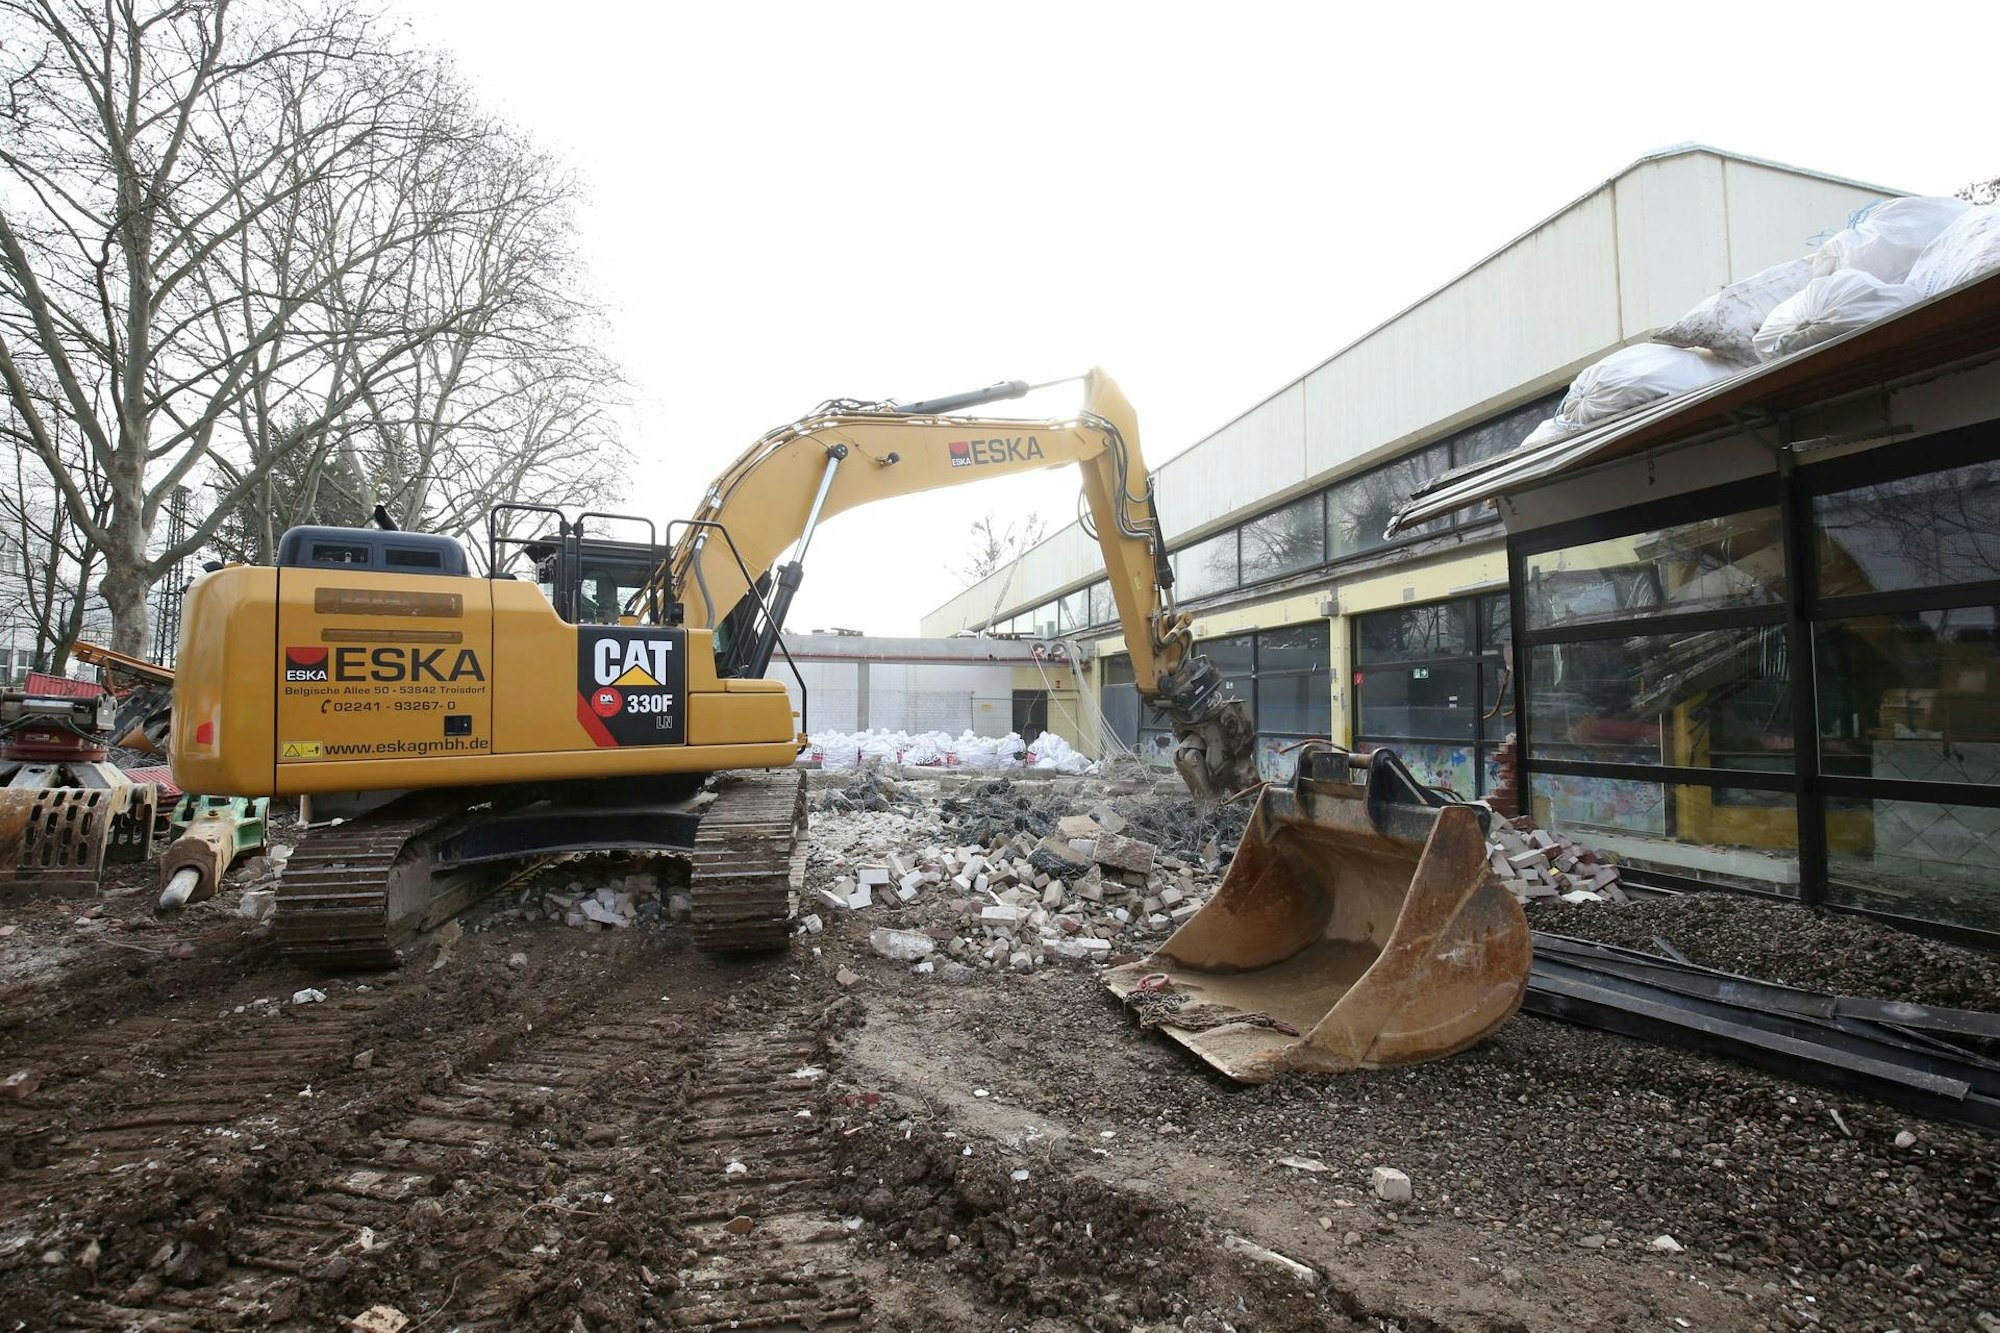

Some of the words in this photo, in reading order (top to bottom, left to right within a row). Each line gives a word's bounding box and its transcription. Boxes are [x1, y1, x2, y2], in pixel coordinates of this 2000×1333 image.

[971, 436, 1045, 465] ESKA
[952, 457, 971, 466] ESKA
[335, 647, 485, 682] ESKA
[594, 638, 673, 686] CAT
[286, 669, 328, 681] ESKA
[285, 686, 340, 697] Belgische
[344, 686, 371, 695] Allee
[374, 686, 390, 694] 50
[440, 685, 486, 694] Troisdorf
[333, 702, 380, 712] 02241
[627, 694, 673, 713] 330F
[655, 716, 673, 729] LN
[325, 737, 489, 755] www.eskagmbh.de
